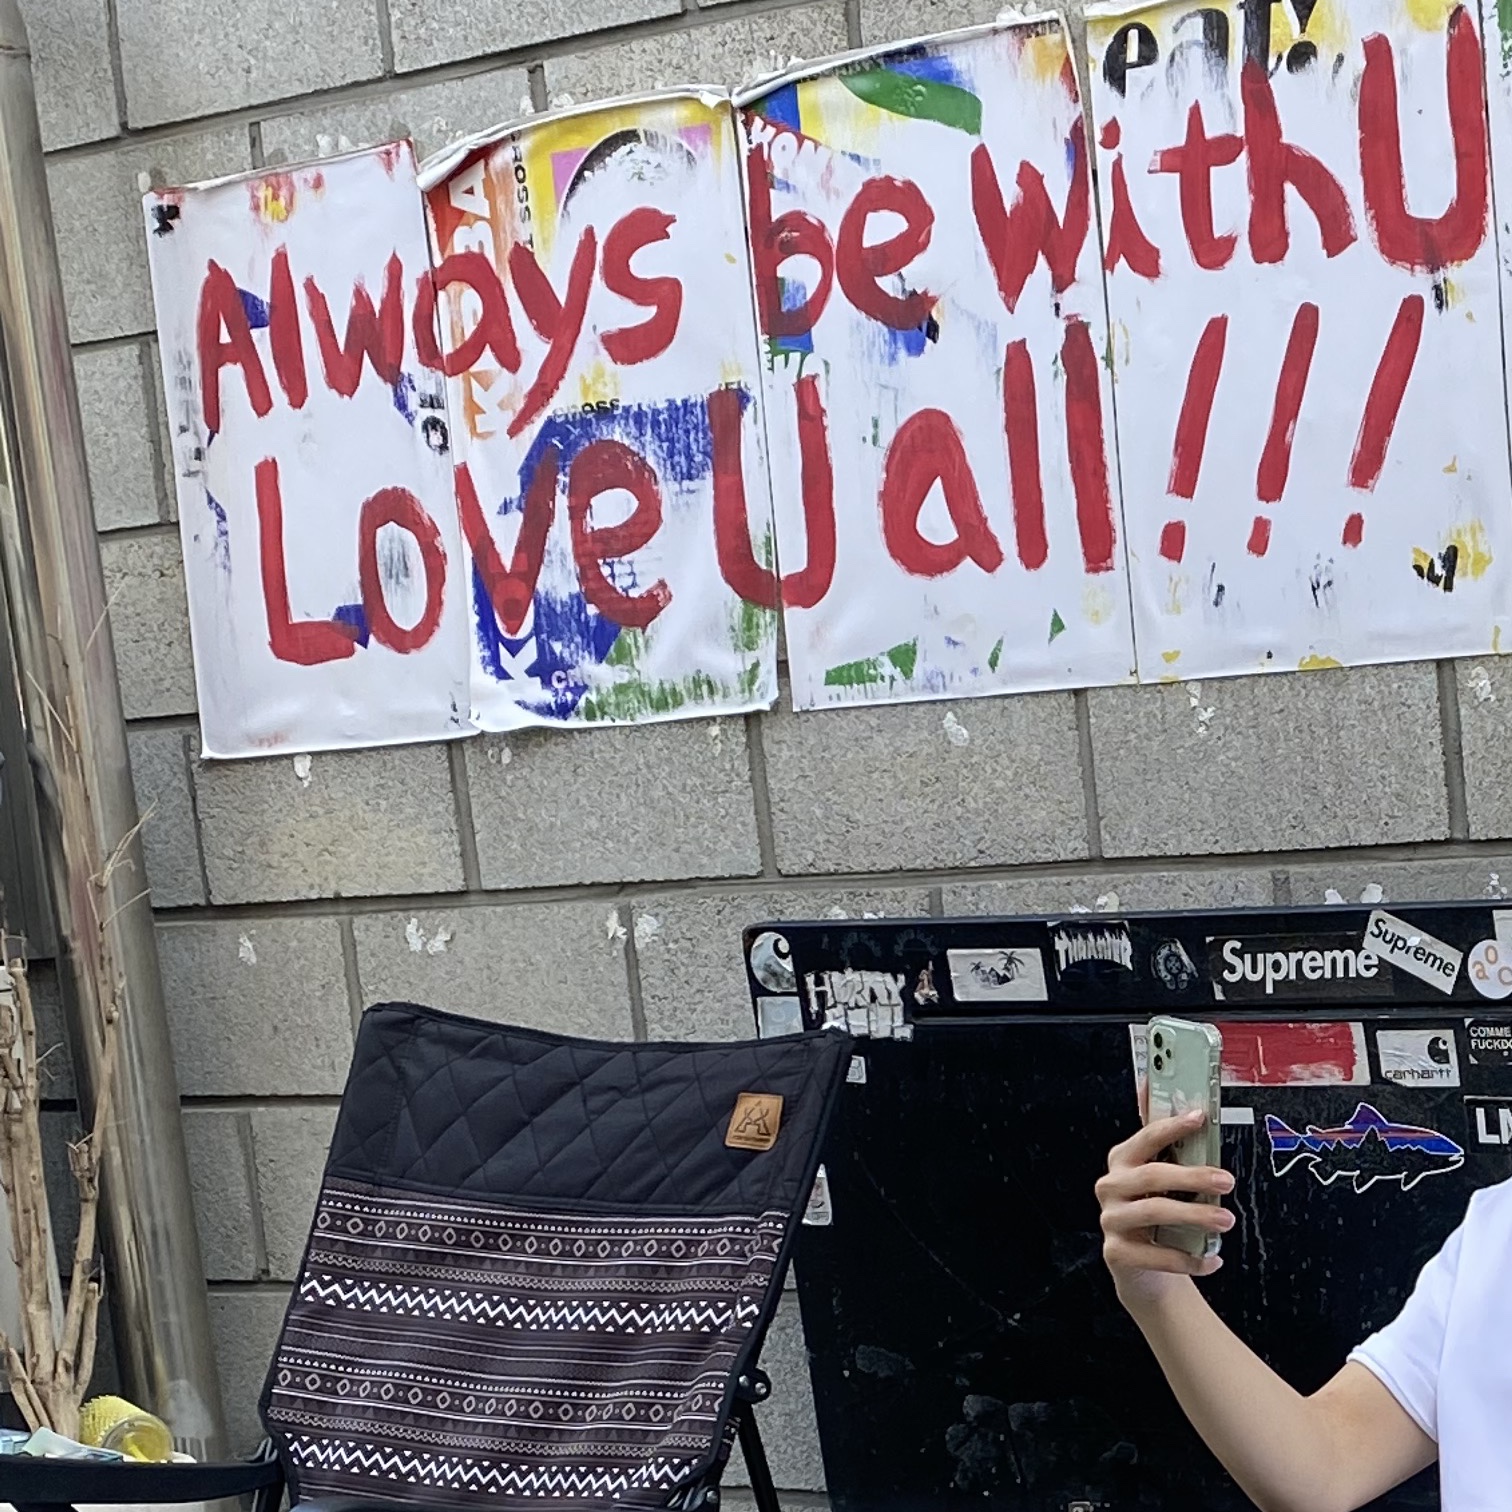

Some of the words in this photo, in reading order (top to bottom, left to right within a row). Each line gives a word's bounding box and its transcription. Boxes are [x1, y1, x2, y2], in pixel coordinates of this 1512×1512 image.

[200, 205, 684, 437] Always
[745, 150, 938, 340] be
[256, 442, 673, 665] Love
[708, 376, 838, 608] U
[1222, 939, 1379, 995] Supreme
[1369, 917, 1456, 978] Supreme
[1385, 1068, 1451, 1081] carhartt
